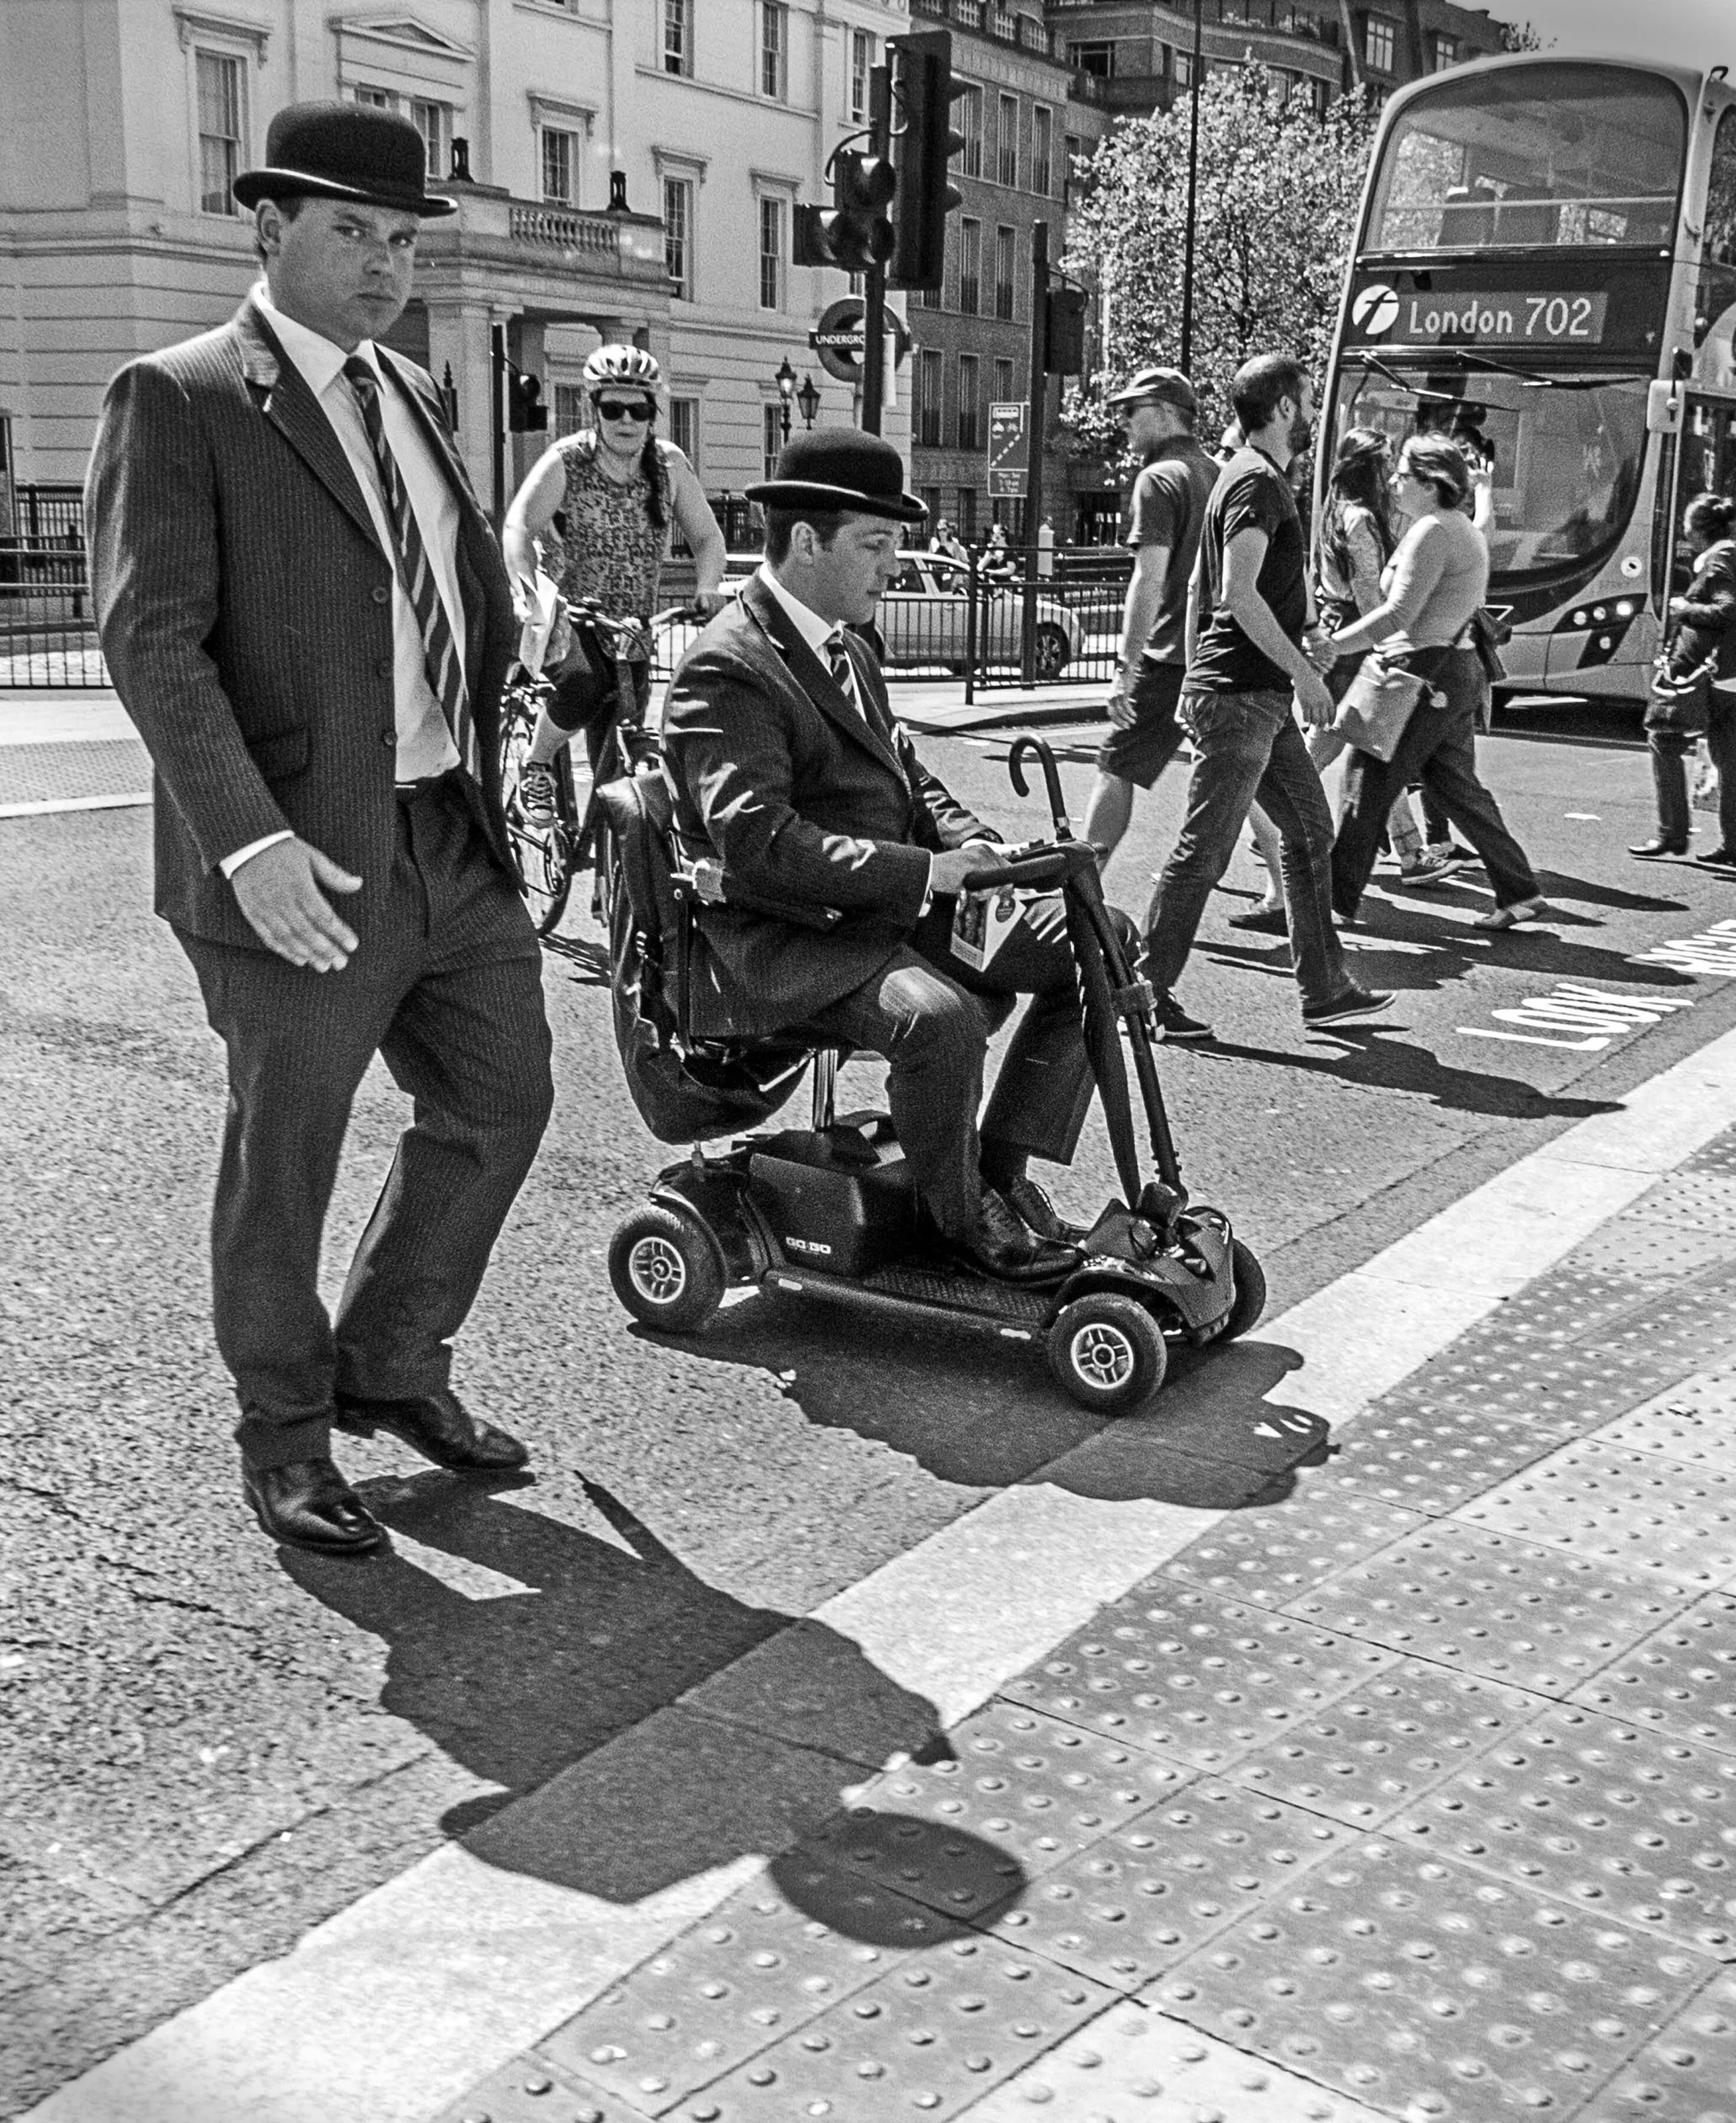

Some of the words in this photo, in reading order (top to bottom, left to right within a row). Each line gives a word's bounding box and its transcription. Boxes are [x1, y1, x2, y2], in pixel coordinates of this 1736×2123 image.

[1409, 301, 1513, 334] London
[1525, 297, 1592, 336] 702
[815, 334, 865, 345] UNDERGRO
[1455, 983, 1694, 1051] LOOK
